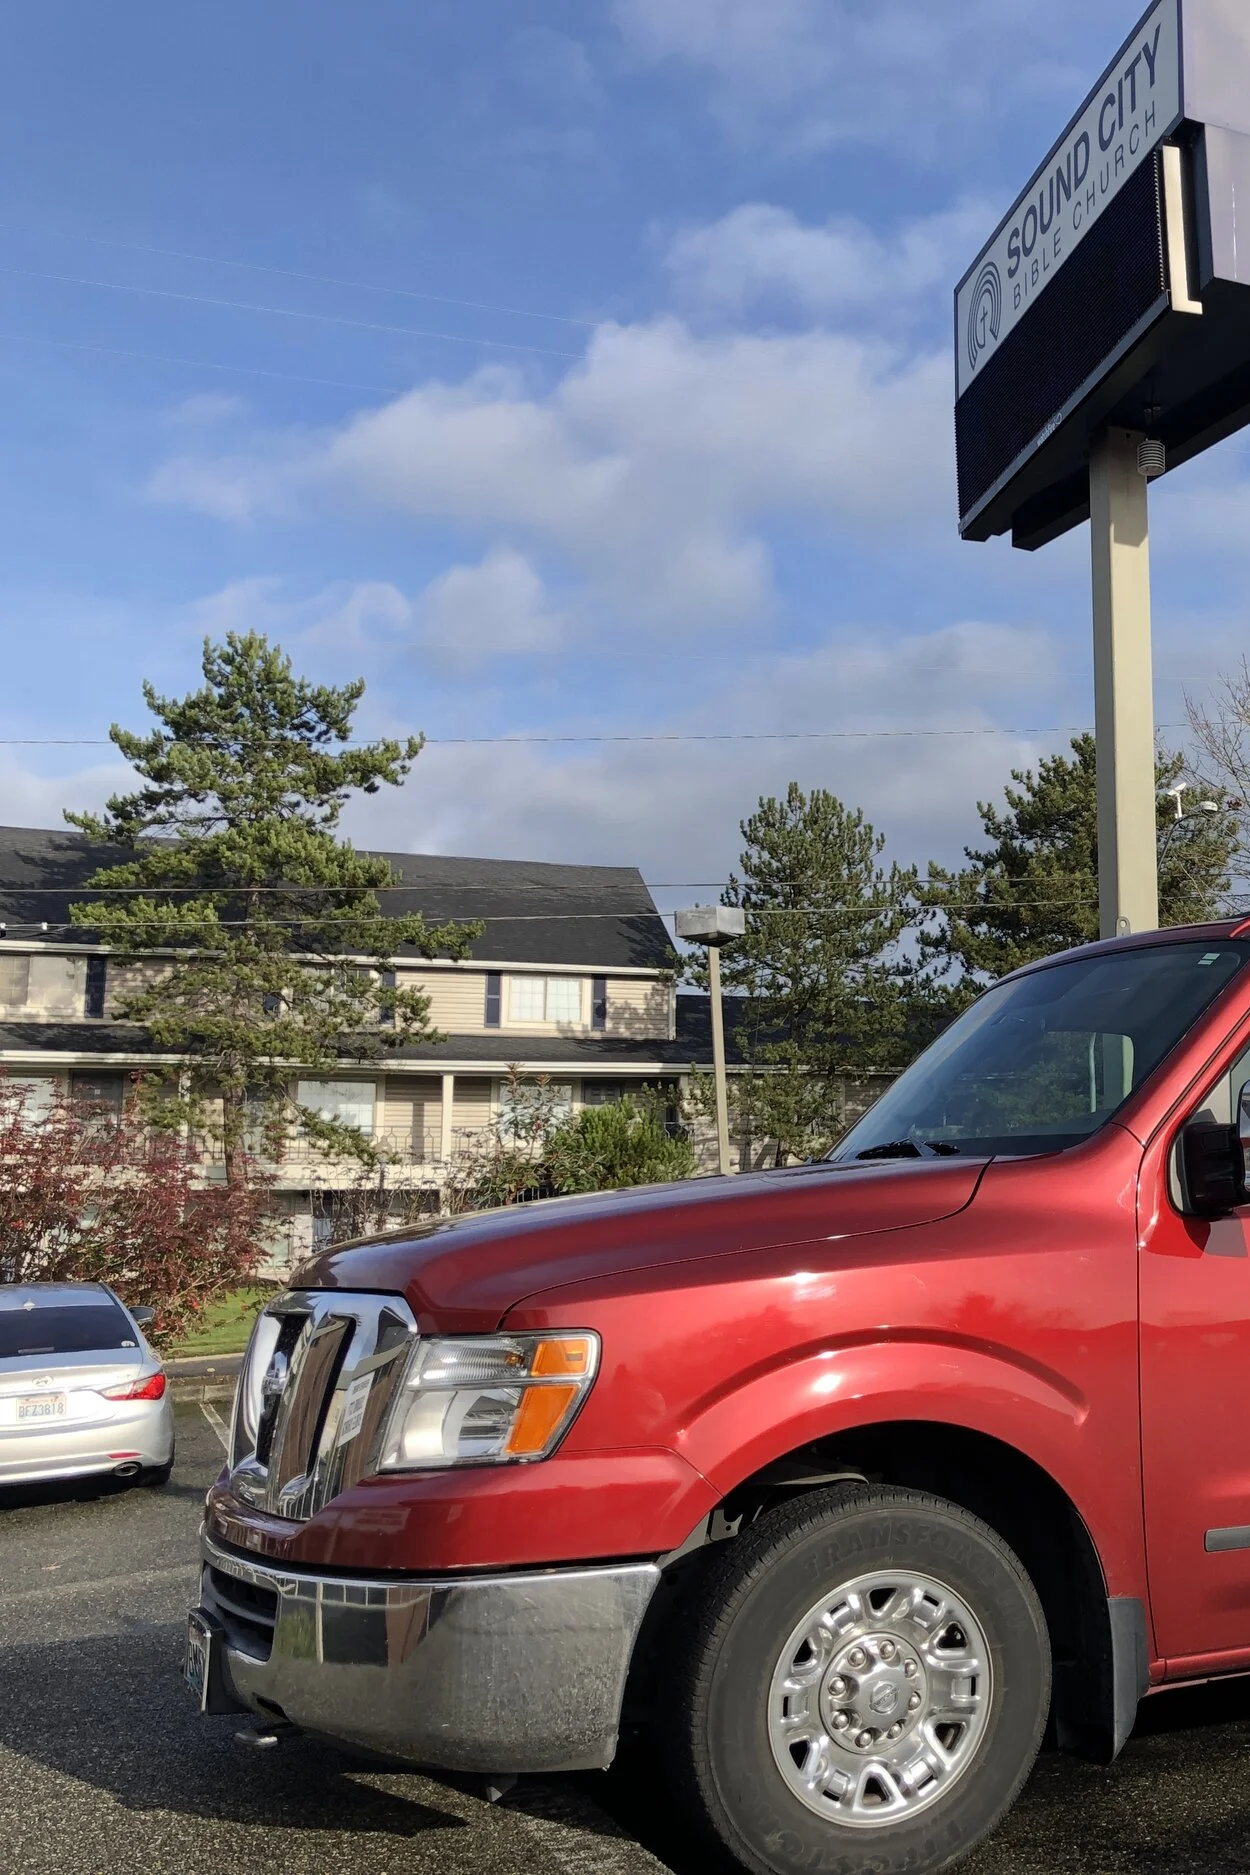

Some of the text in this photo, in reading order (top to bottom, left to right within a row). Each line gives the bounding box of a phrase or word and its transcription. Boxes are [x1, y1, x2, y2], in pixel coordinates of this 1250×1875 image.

[1007, 22, 1161, 279] SOUND CITY
[1013, 100, 1155, 310] BIBLE CHURCH
